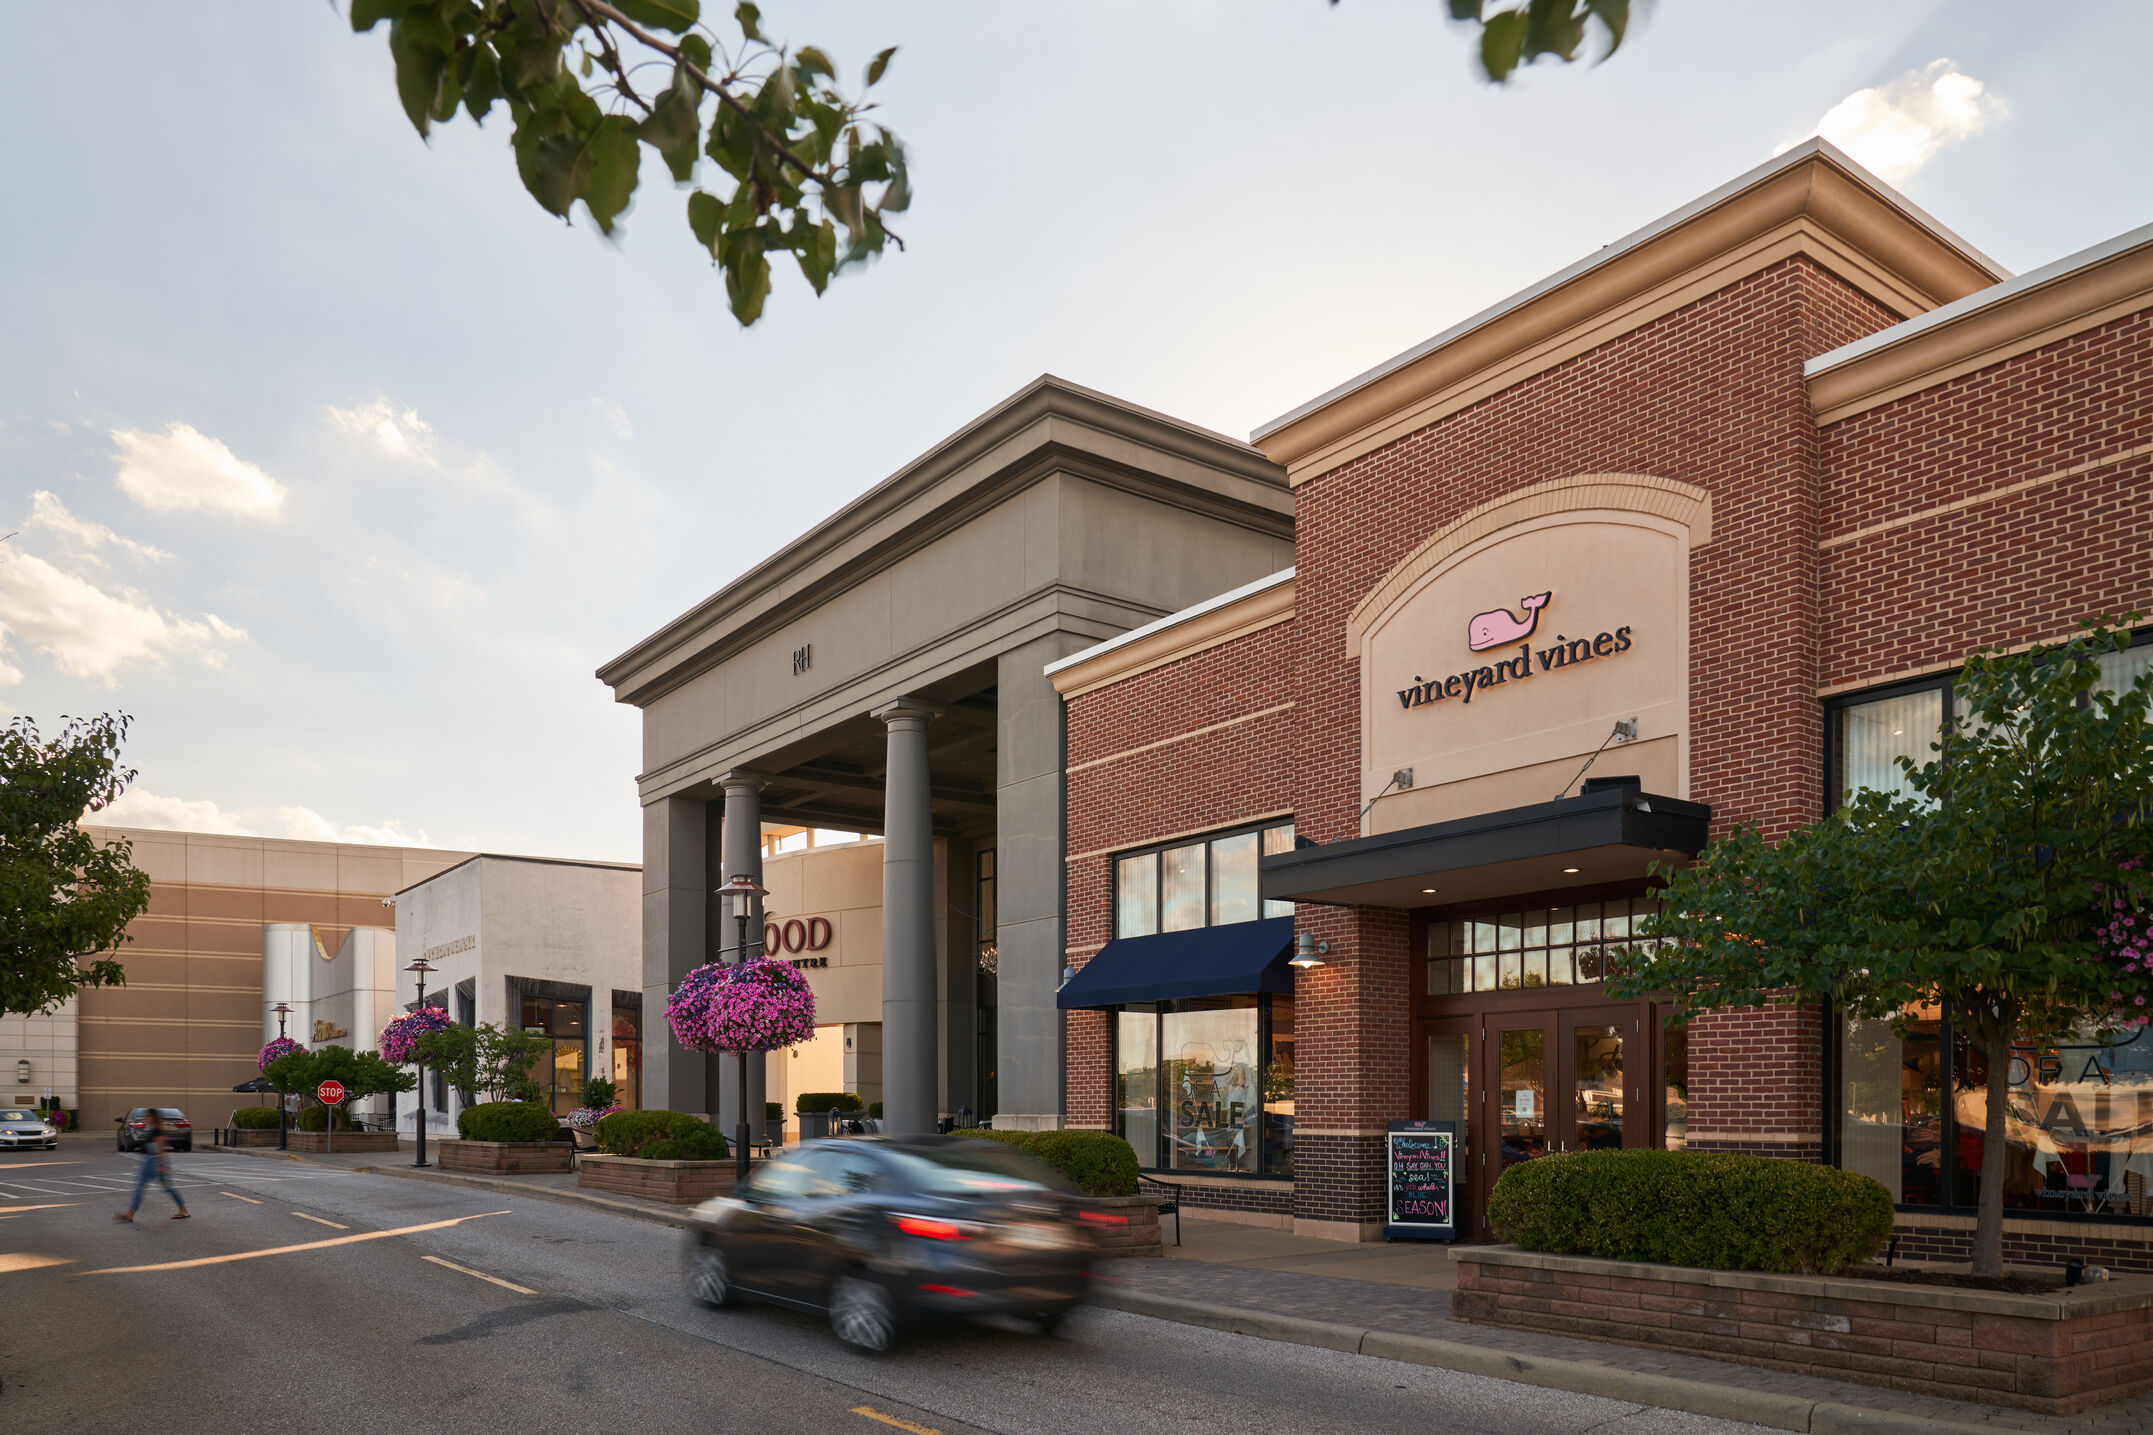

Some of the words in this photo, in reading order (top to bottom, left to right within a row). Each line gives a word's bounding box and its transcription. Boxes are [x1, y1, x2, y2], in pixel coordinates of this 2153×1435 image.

[792, 643, 811, 676] RH
[1396, 643, 1533, 710] vineyard
[1535, 625, 1633, 671] vines
[2007, 1055, 2060, 1086] OF
[2078, 1055, 2111, 1085] A
[319, 1087, 343, 1097] STOP
[1180, 1079, 1204, 1098] OF
[1208, 1080, 1221, 1098] A
[1180, 1100, 1244, 1129] SALE
[1408, 1171, 1430, 1182] sea!
[2035, 1186, 2095, 1201] vineyard
[2095, 1188, 2133, 1201] vines
